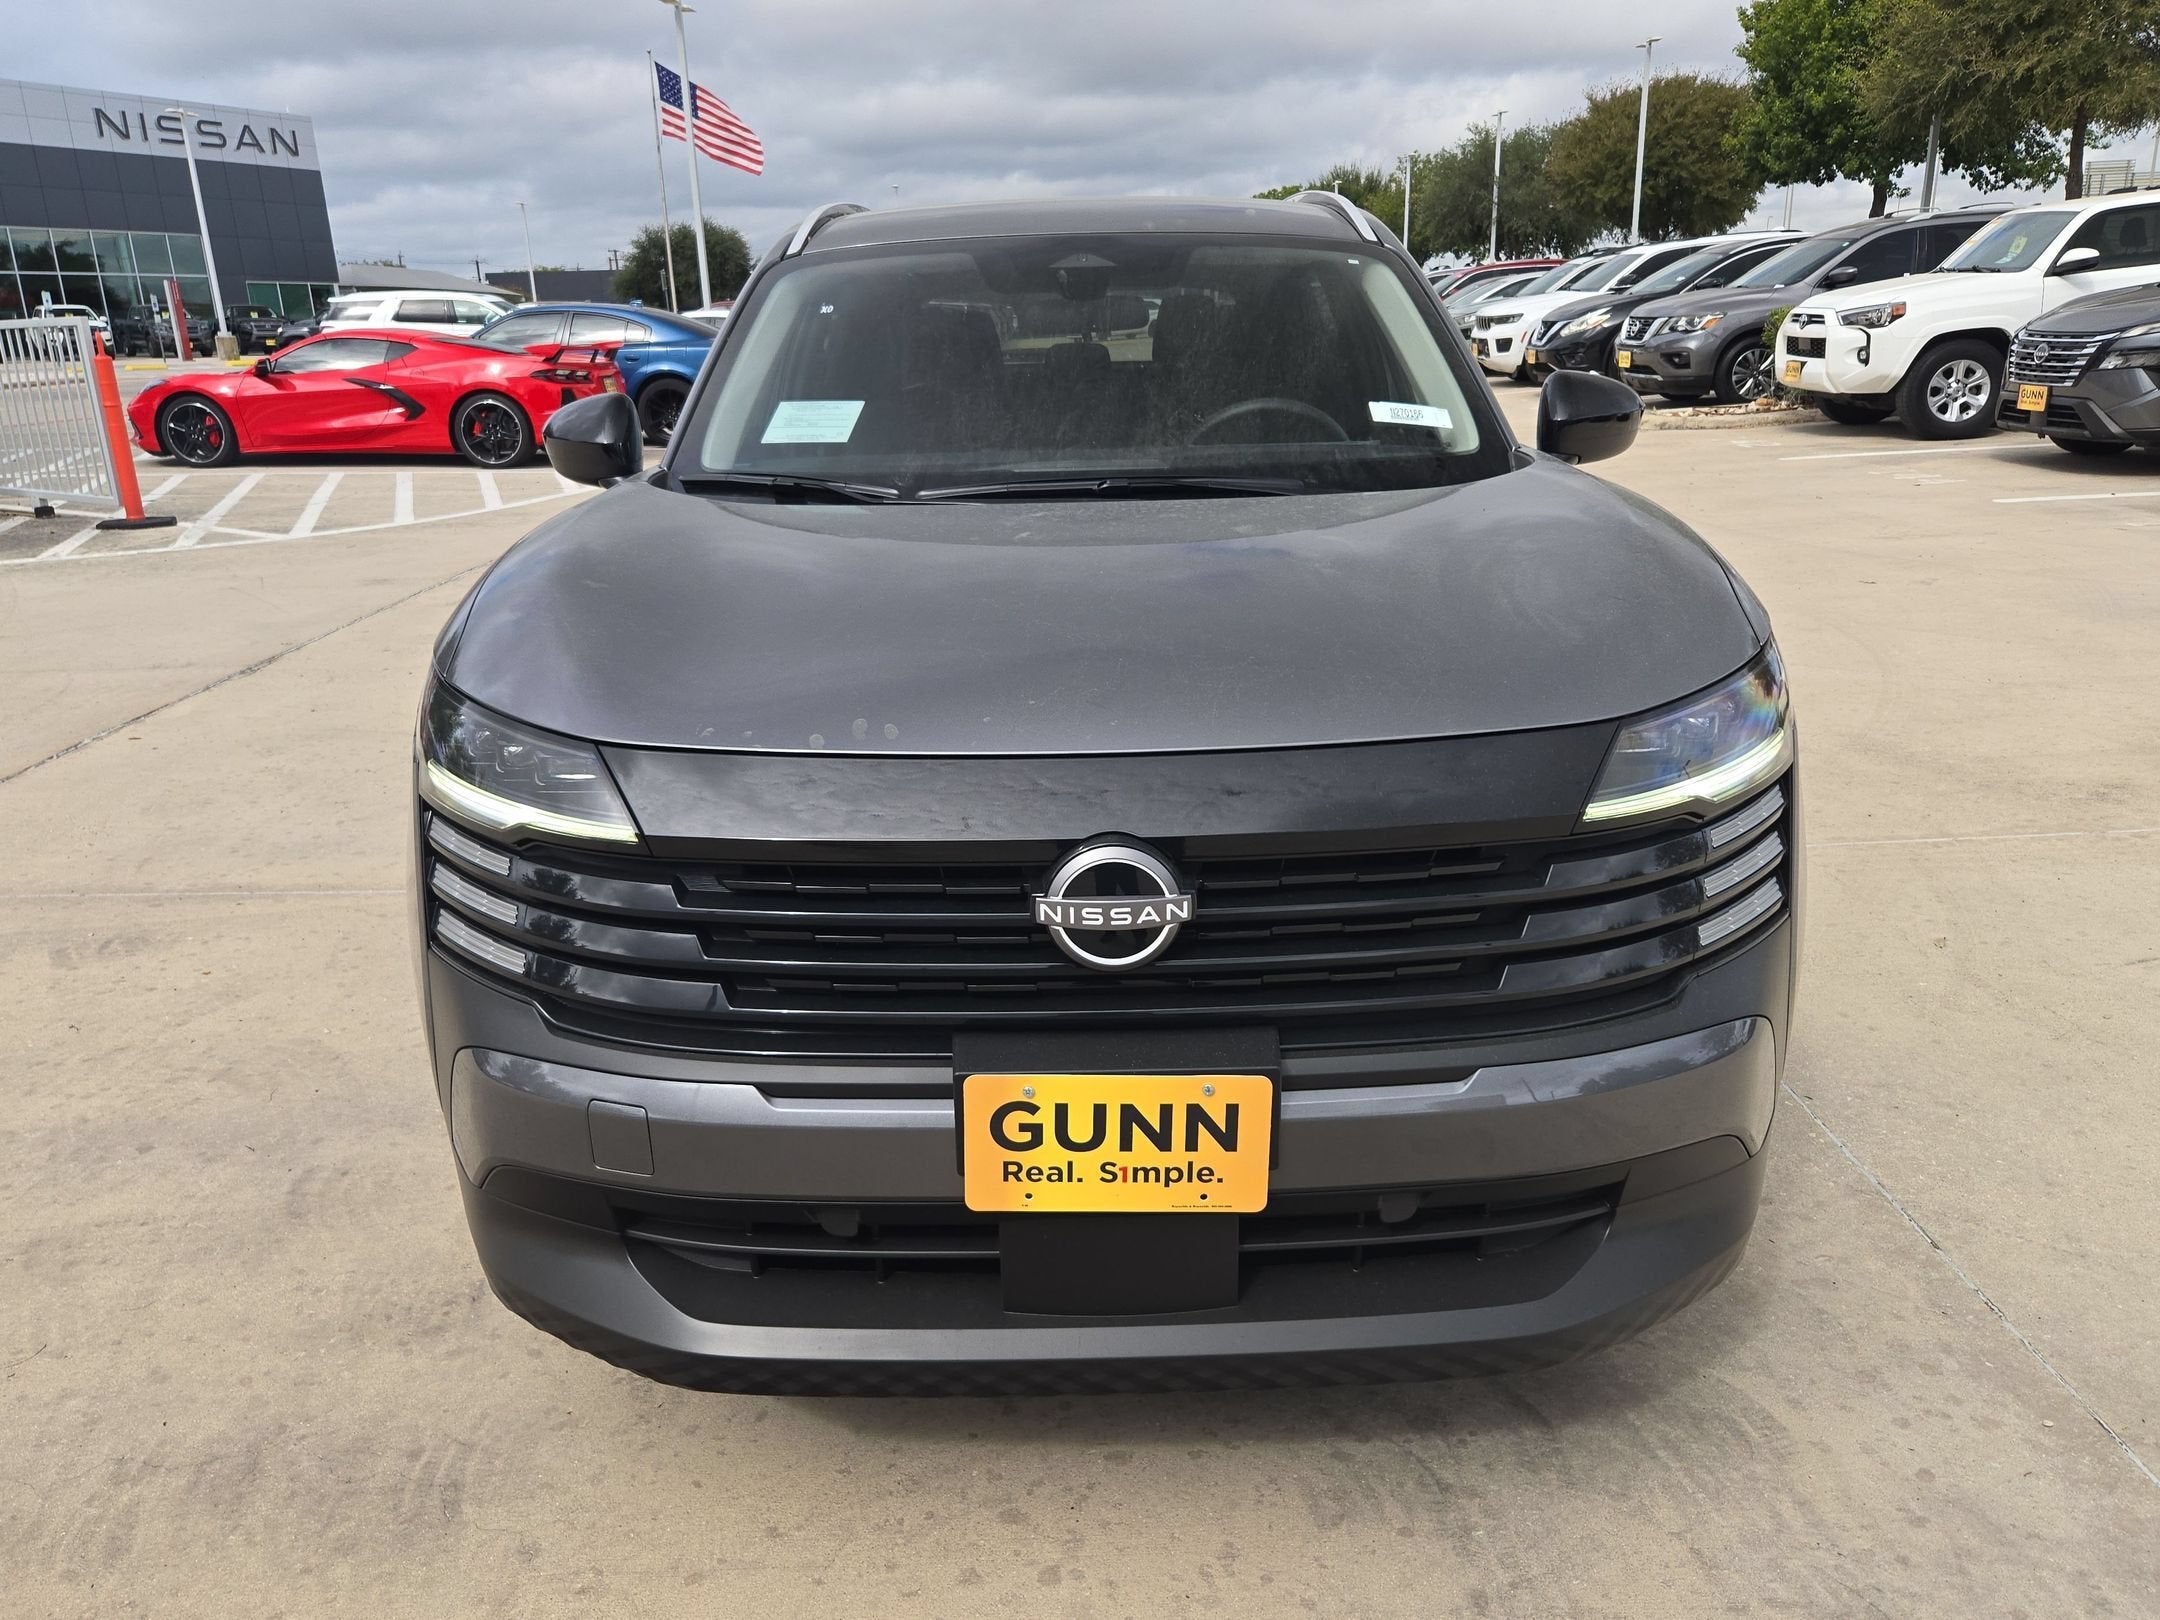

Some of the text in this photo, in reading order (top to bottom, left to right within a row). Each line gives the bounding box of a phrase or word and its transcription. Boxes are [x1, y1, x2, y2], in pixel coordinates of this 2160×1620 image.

[93, 107, 300, 157] NISSAN
[2020, 388, 2045, 400] GUNN
[1039, 901, 1188, 926] NISSAN
[989, 1100, 1239, 1153] GUNN
[1002, 1160, 1083, 1183] Real.
